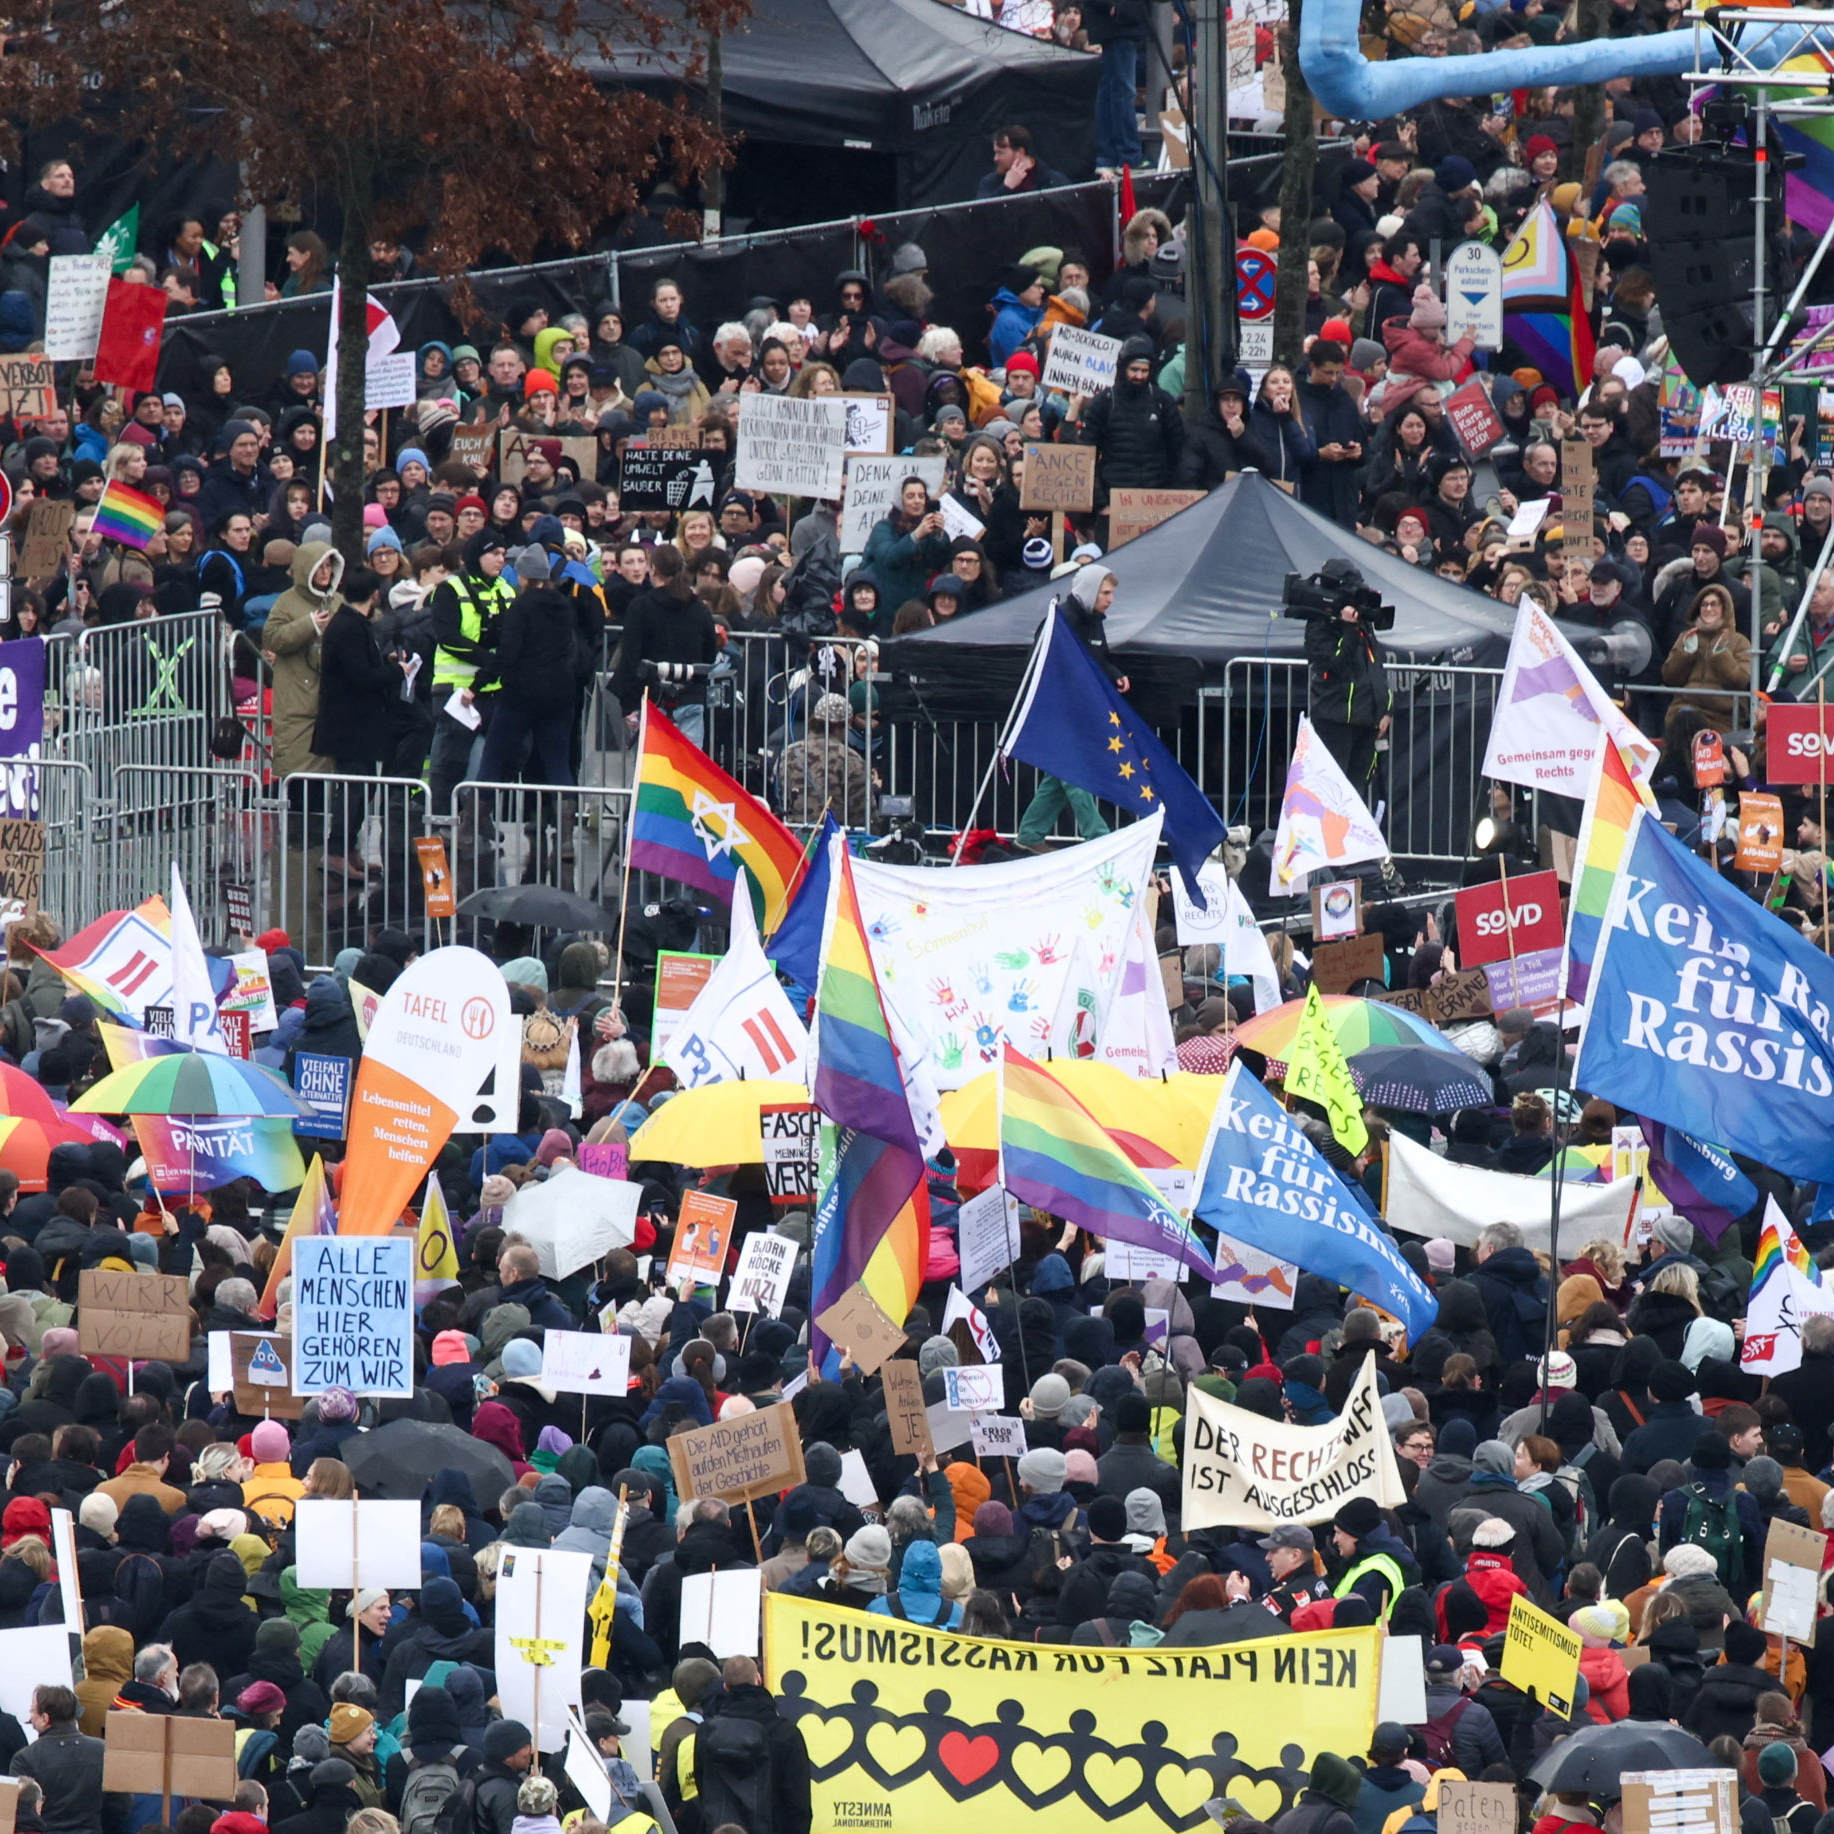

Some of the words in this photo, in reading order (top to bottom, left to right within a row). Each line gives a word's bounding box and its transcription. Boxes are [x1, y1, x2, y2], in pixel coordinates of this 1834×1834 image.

[1467, 247, 1481, 260] 30
[624, 463, 666, 476] UMWELT
[625, 450, 662, 462] HALTE
[663, 450, 692, 462] DEINE
[622, 480, 662, 494] SAUBER
[855, 463, 893, 485] DENK
[1497, 749, 1567, 766] Gemeinsam
[1536, 764, 1576, 780] Rechts
[4, 852, 40, 871] STATT
[1609, 872, 1750, 968] Kein
[403, 991, 448, 1024] TAFEL
[1672, 957, 1791, 1035] für
[396, 1029, 462, 1060] DEUTSCHLAND
[301, 1057, 345, 1074] VIELFALT
[299, 1088, 343, 1103] ALTERNATIVE
[301, 1071, 343, 1094] OHNE
[362, 1090, 432, 1117] Lebensmittel
[373, 1126, 428, 1149] Menschen
[392, 1117, 429, 1133] retten.
[1221, 1097, 1316, 1153] Kein
[170, 1128, 255, 1158] PARITÄT
[387, 1145, 427, 1165] helfen.
[1259, 1146, 1333, 1194] für
[1221, 1164, 1435, 1304] Rassismus!
[317, 1246, 391, 1275] ALLE
[752, 1238, 787, 1259] BJÖRN
[748, 1253, 782, 1275] HÖCKE
[91, 1276, 179, 1308] WIRR
[301, 1278, 406, 1310] MENSCHEN
[740, 1277, 777, 1302] NAZI
[317, 1311, 374, 1333] HIER
[302, 1333, 401, 1358] GEHÖREN
[303, 1360, 351, 1387] ZUM
[358, 1360, 405, 1388] WIR
[686, 1435, 707, 1457] Die
[709, 1429, 734, 1450] AfD
[734, 1419, 769, 1445] gehört
[727, 1438, 782, 1465] Misthaufen
[1193, 1415, 1248, 1468] DER
[694, 1477, 715, 1497] der
[716, 1463, 771, 1491] Geschichte
[1191, 1463, 1232, 1495] IST
[1509, 1623, 1534, 1652] TÖTET.
[1511, 1603, 1579, 1660] ANTISEMITISMUS
[1440, 1784, 1507, 1821] Paten
